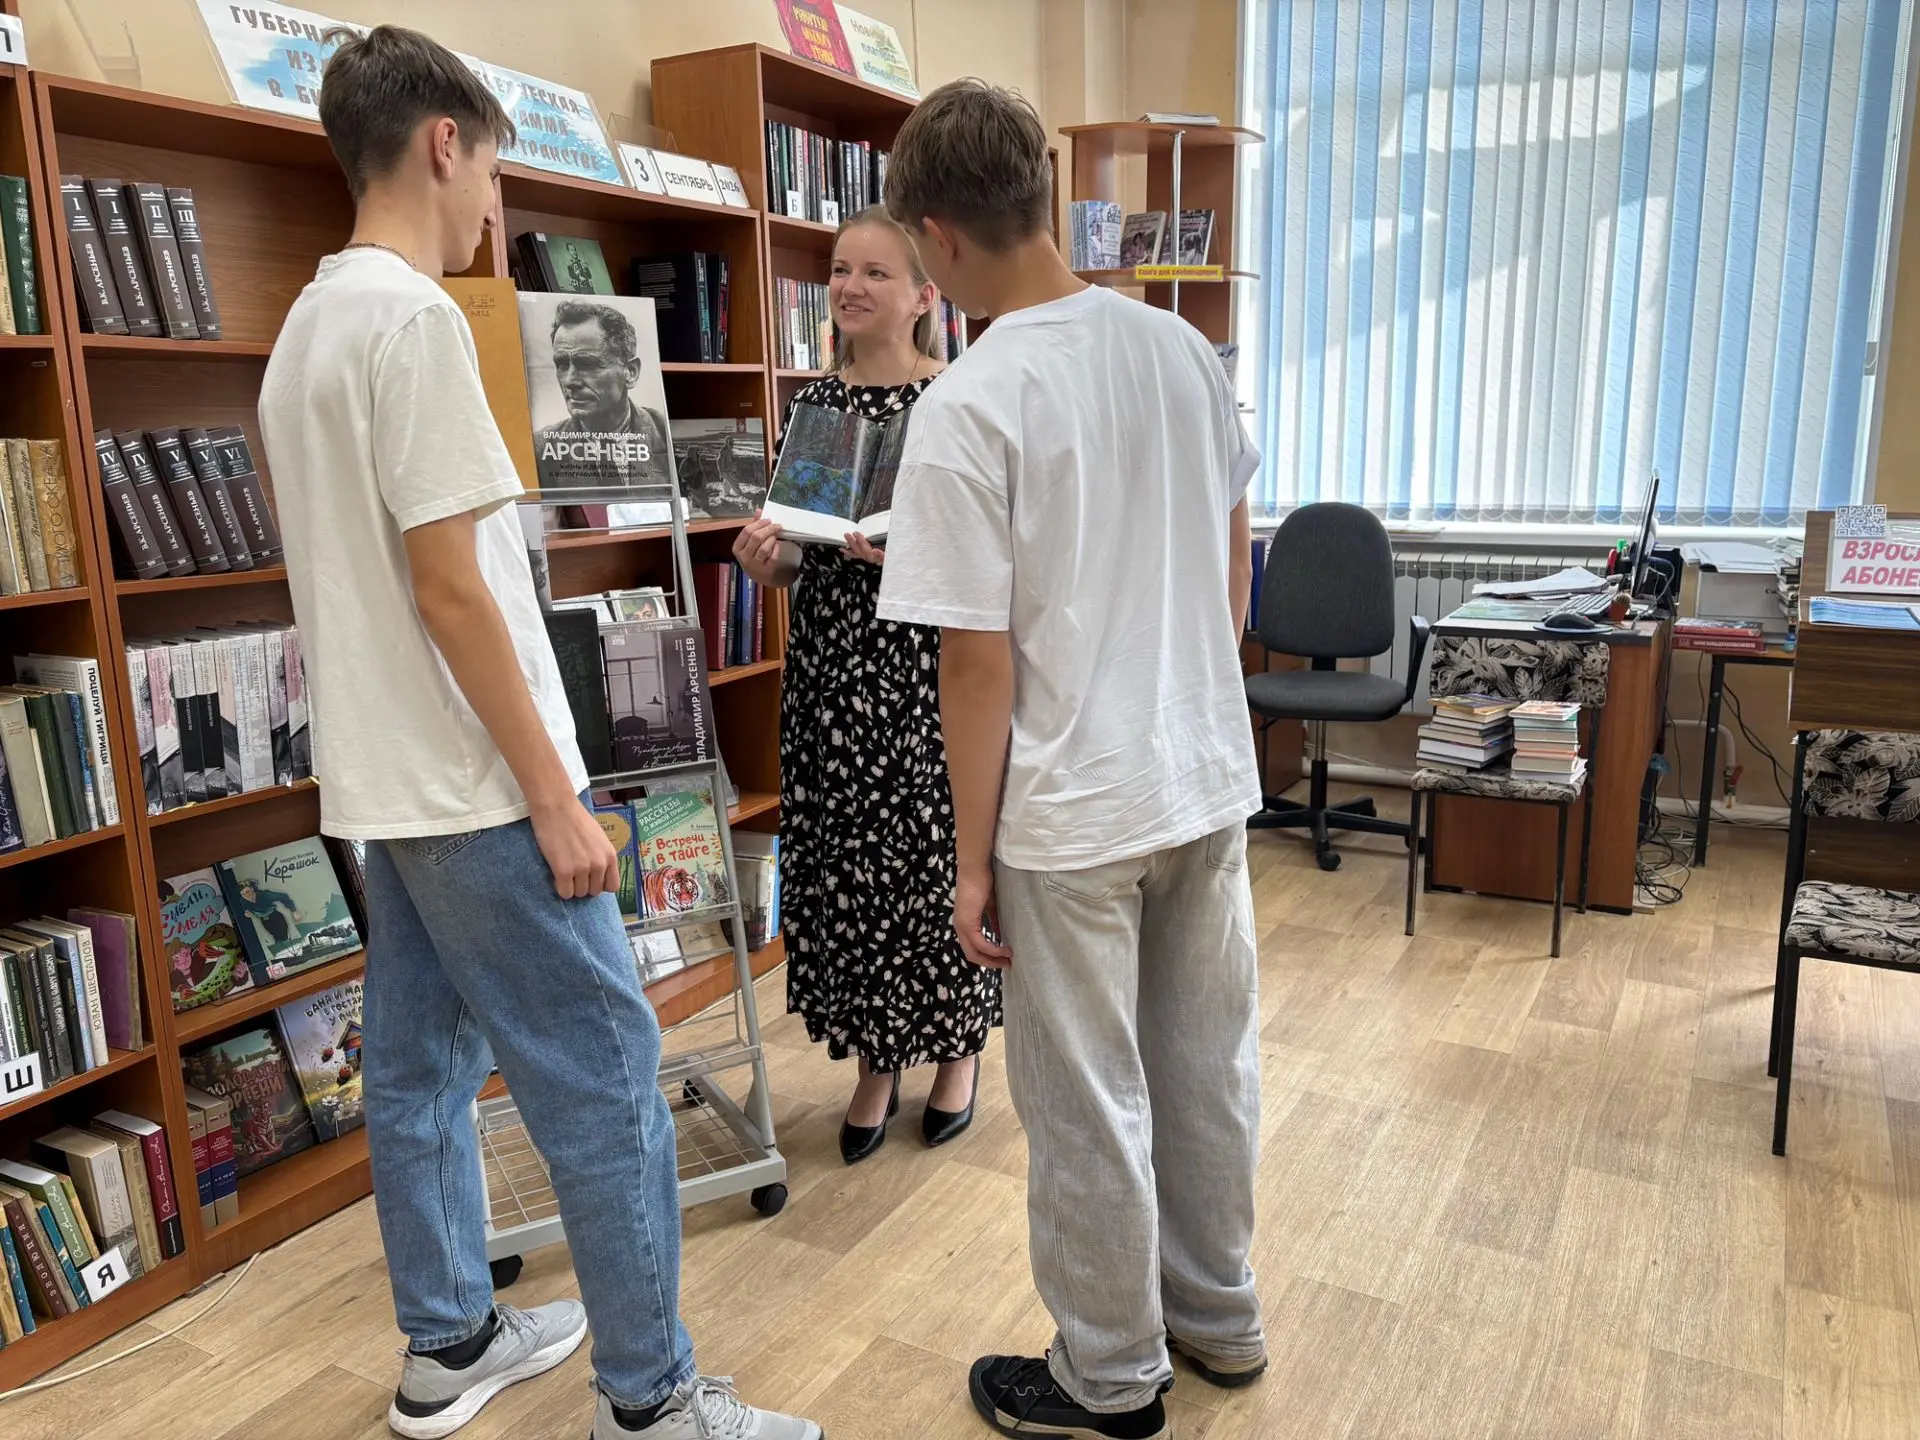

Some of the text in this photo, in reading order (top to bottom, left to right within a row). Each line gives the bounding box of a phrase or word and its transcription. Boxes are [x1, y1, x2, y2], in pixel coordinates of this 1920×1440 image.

[266, 78, 284, 98] В
[635, 157, 649, 182] 3
[664, 171, 713, 191] СЕНТЯБРЬ
[73, 197, 81, 211] I
[111, 201, 119, 214] I
[150, 205, 163, 218] II
[792, 198, 798, 213] Б
[178, 209, 194, 223] III
[827, 206, 834, 220] К
[799, 350, 804, 365] Т
[543, 431, 646, 440] ВЛАДИМИР КЛАВДИЕВИЧ
[100, 450, 117, 467] IV
[169, 449, 181, 462] V
[199, 450, 210, 462] V
[224, 447, 242, 460] VI
[541, 442, 650, 462] АРСЕНЬЕВ
[132, 453, 147, 468] IV
[1840, 566, 1920, 587] АБОНЕ
[685, 637, 707, 762] ВЛАДИМИР АРСЕНЬЕВ
[87, 667, 109, 765] ПОЦЕЛУЙ ТИГРИЦЫ
[639, 799, 681, 826] РАССКАЗЫ
[656, 833, 705, 850] Встречи
[656, 844, 710, 864] в тайге
[268, 964, 285, 978] 16+
[82, 939, 104, 1031] ЮВАН ШЕСТАЛОВ
[5, 1065, 34, 1094] Ш
[97, 1263, 116, 1288] Я
